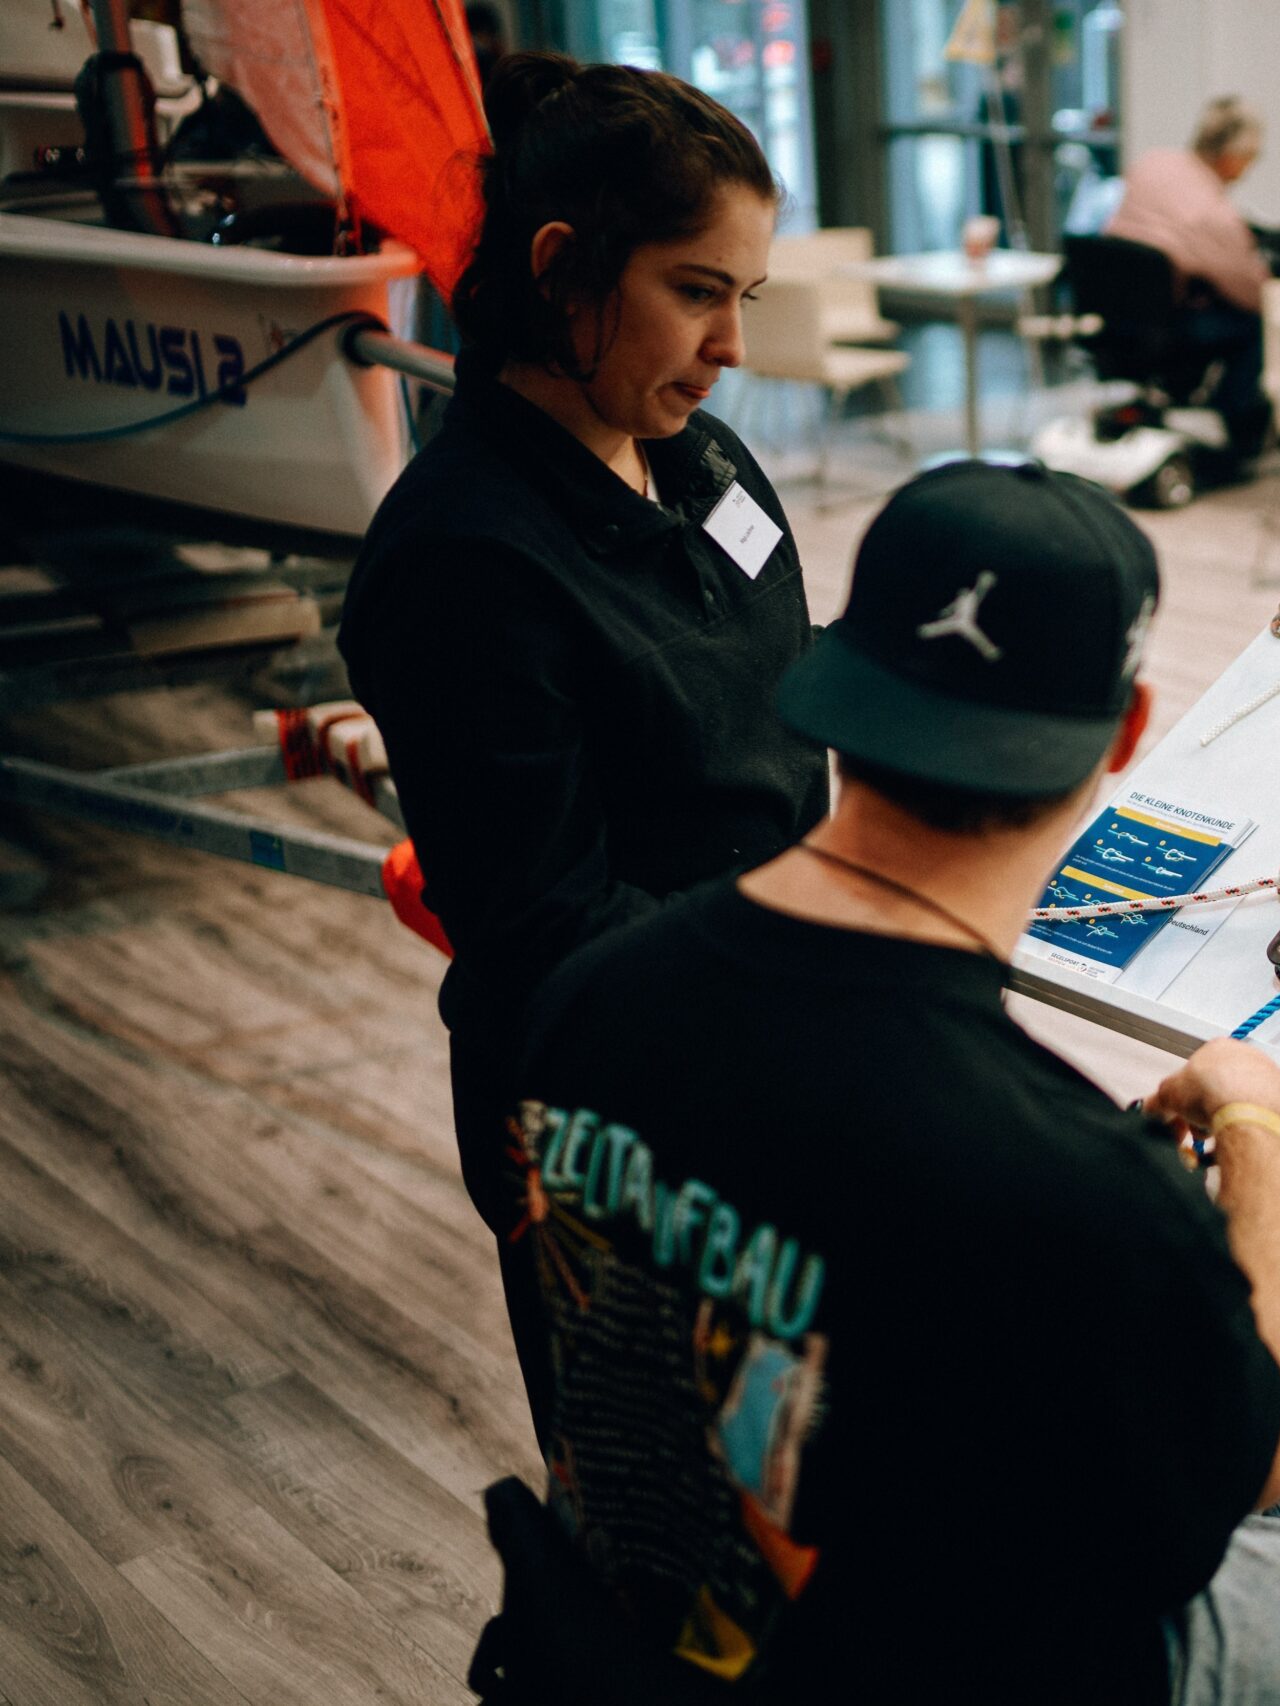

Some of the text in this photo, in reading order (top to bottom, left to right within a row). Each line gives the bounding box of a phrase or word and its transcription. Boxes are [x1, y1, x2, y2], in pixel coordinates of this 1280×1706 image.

[59, 309, 208, 402] MAUSI
[1129, 791, 1145, 802] DIE
[1145, 797, 1175, 812] KLEINE
[1174, 807, 1236, 830] KNOTENKUNDE
[1167, 917, 1209, 936] Deutschland
